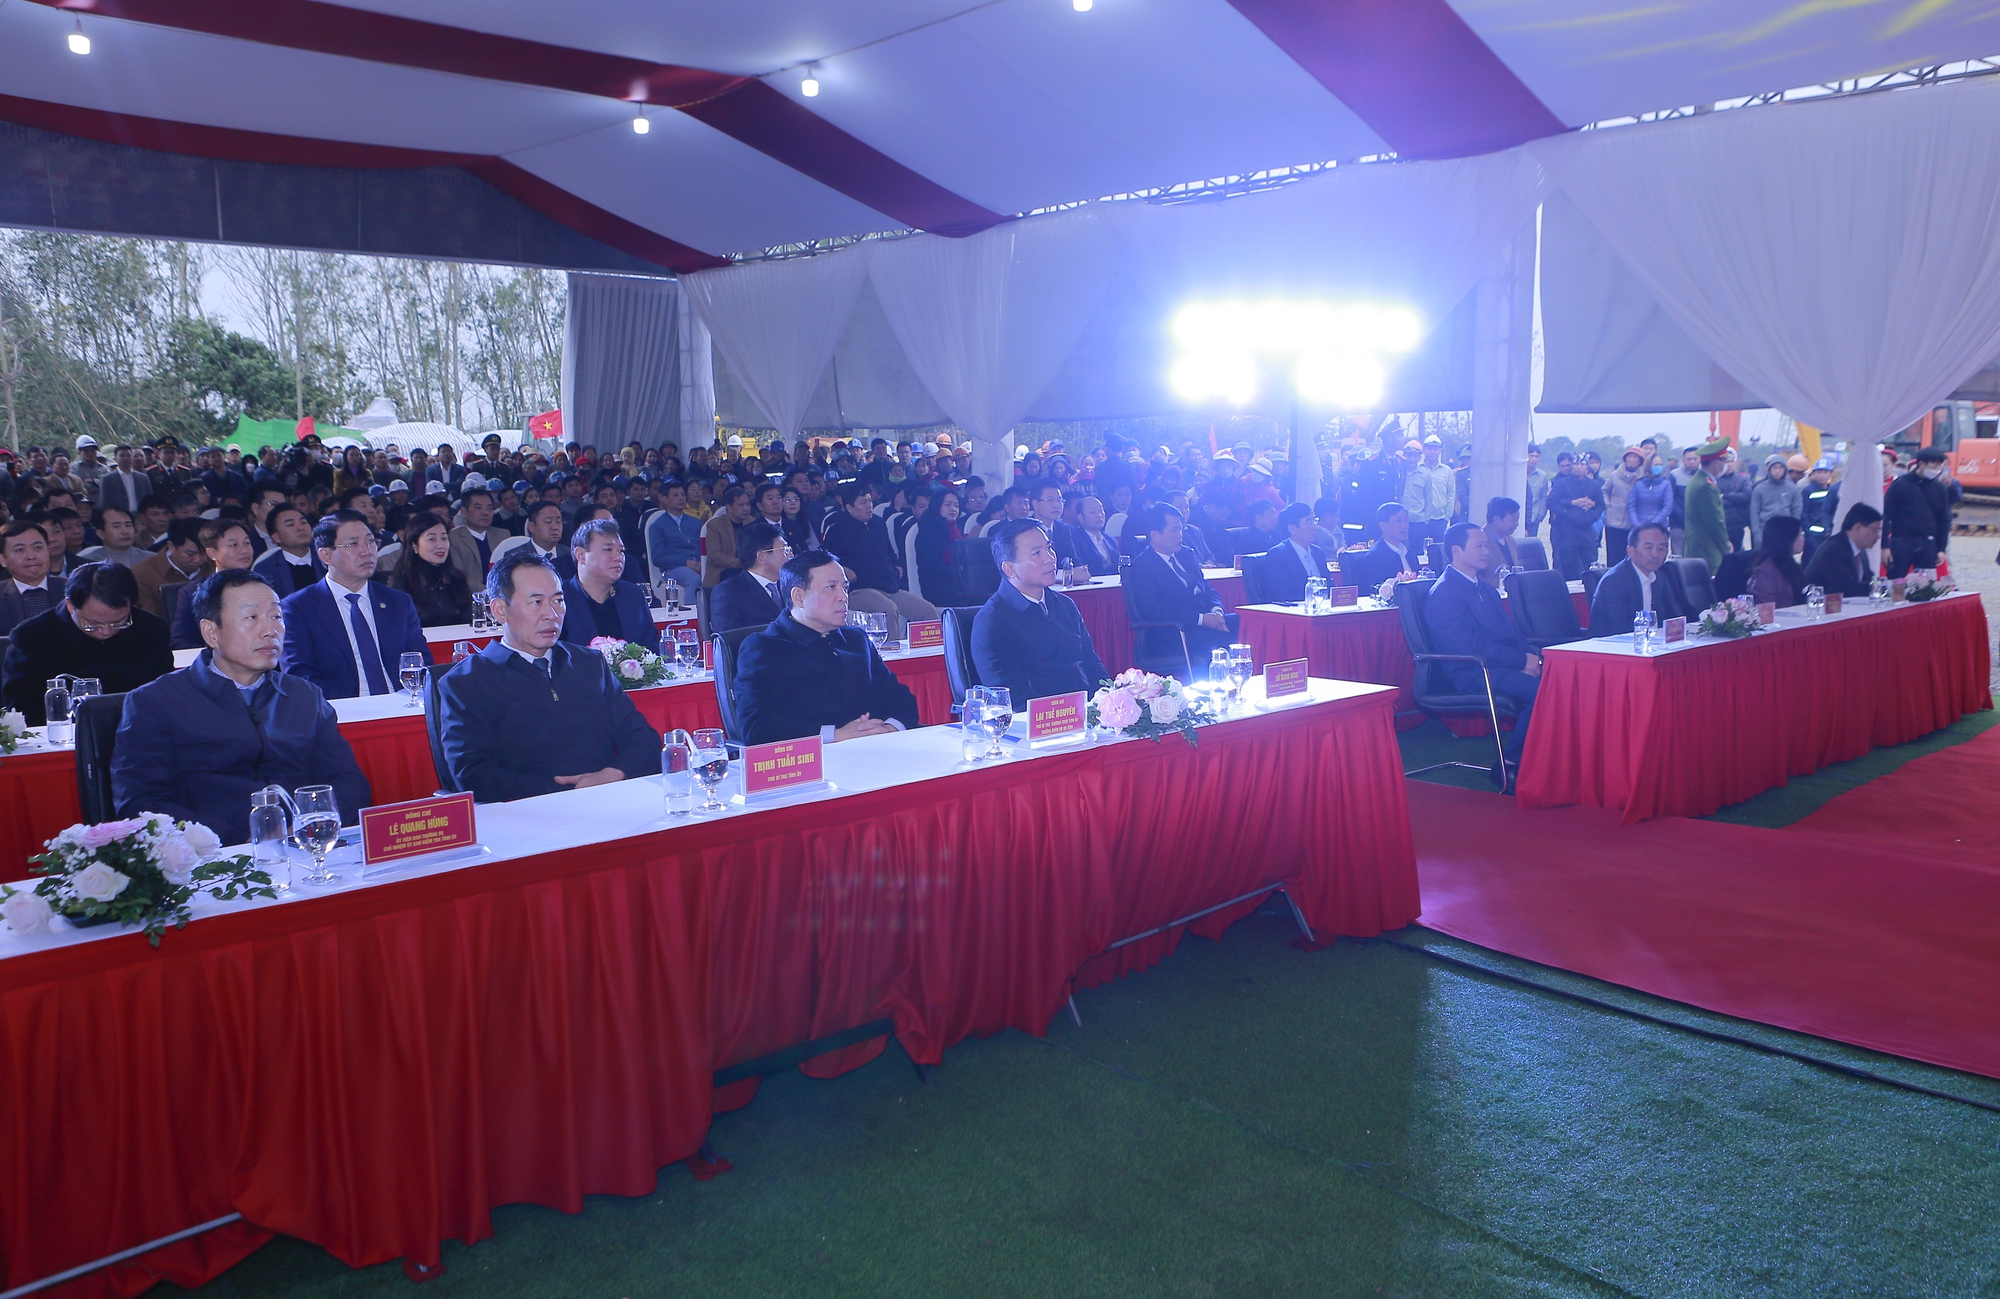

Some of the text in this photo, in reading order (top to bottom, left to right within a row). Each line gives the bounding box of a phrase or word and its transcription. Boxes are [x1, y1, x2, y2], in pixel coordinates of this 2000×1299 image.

[1036, 706, 1076, 723] LẠI THẾ NGUYÊN
[754, 753, 814, 775] TRỊNH TUẤN SINH
[388, 822, 399, 836] LÊ
[400, 821, 426, 835] QUANG
